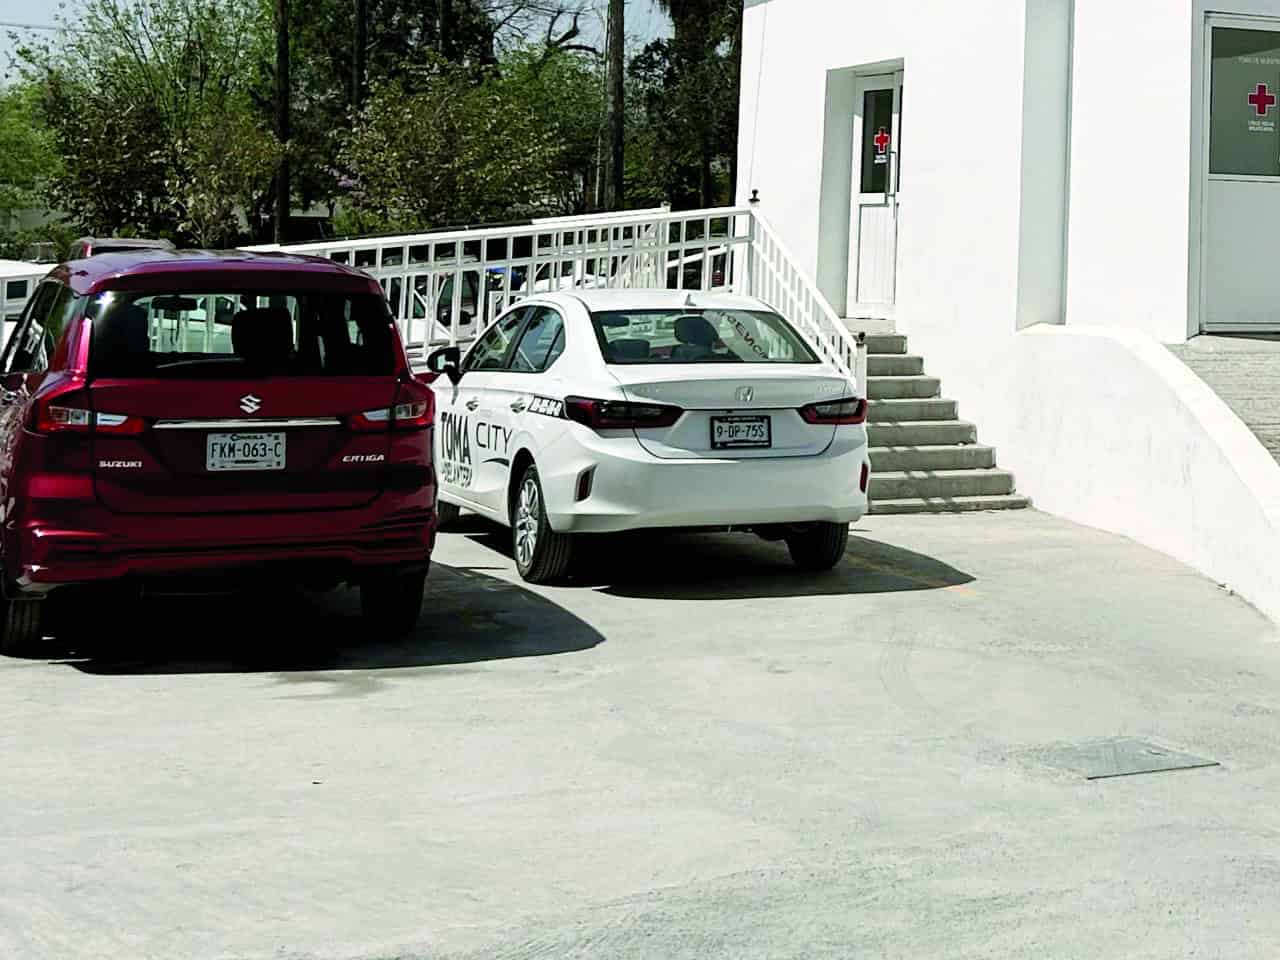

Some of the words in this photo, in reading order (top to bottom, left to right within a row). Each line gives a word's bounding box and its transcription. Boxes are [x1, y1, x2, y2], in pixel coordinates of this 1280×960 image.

[211, 442, 281, 459] FKM-063-C
[441, 411, 471, 464] TOMA
[476, 422, 512, 455] CITY
